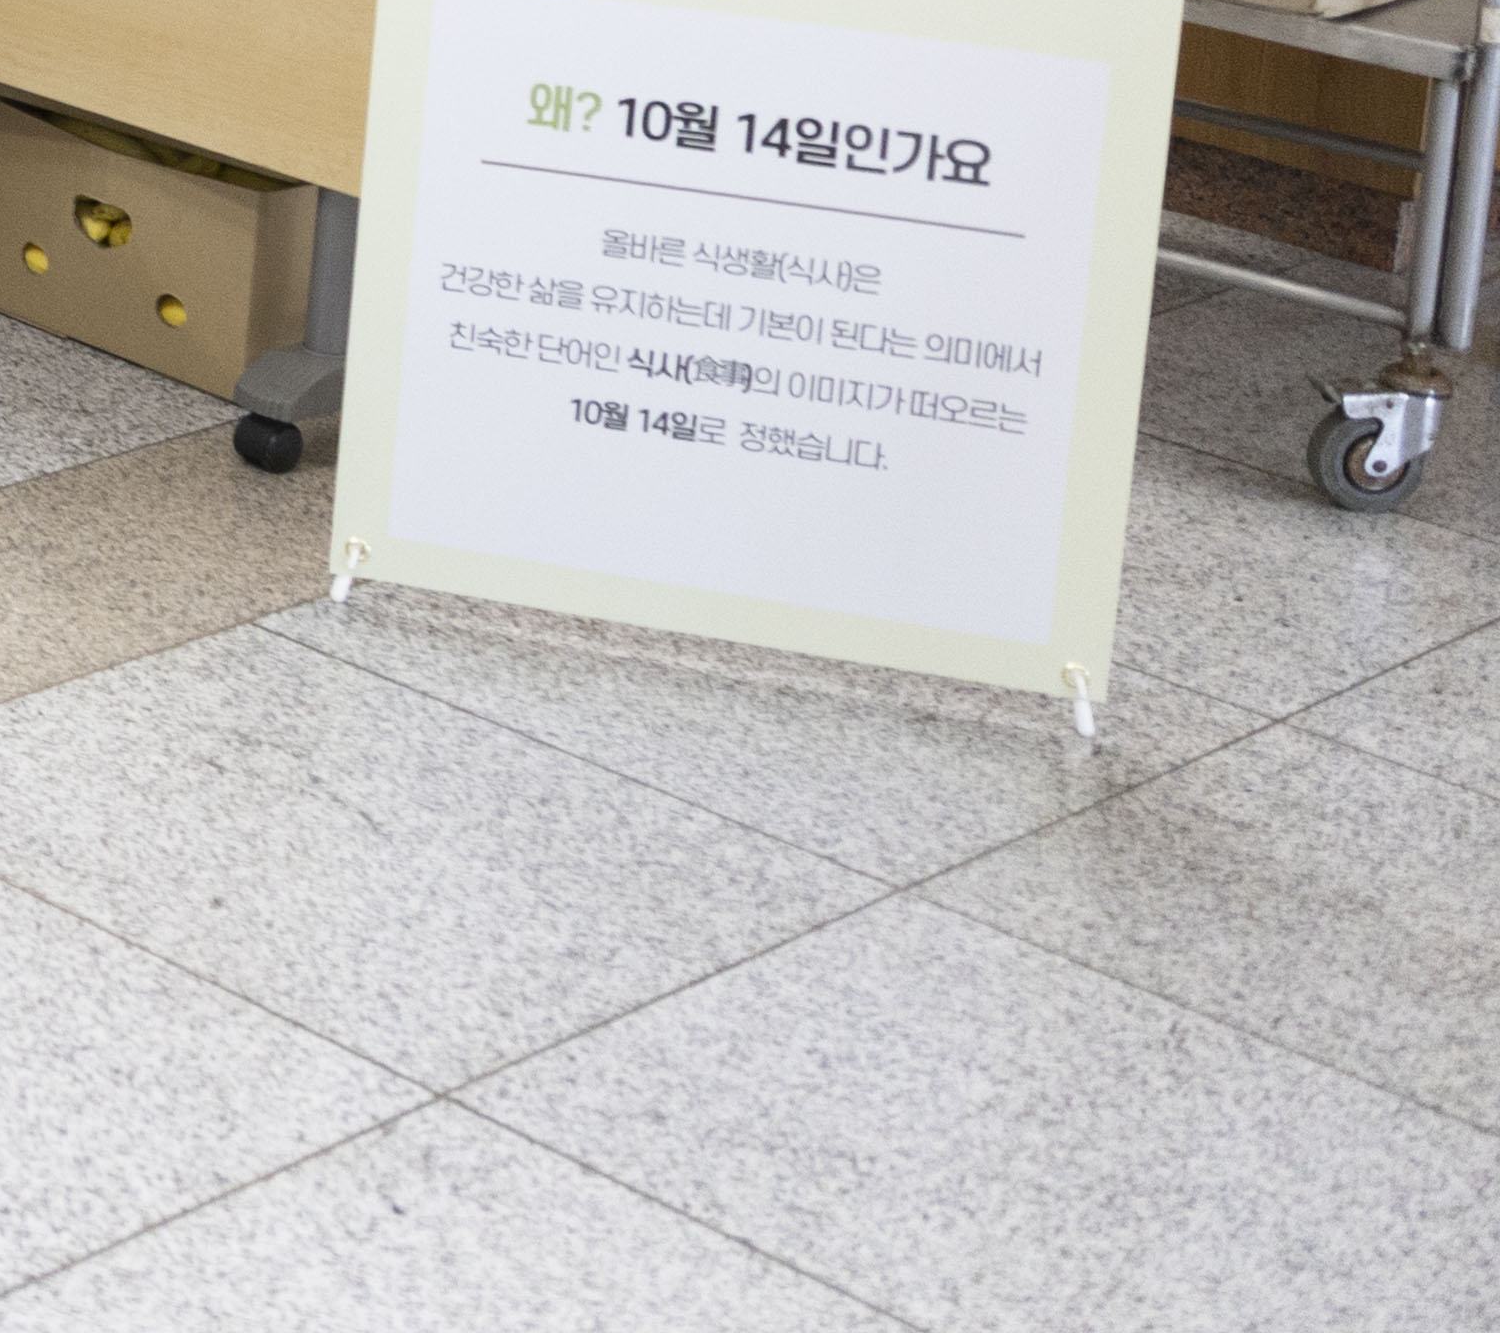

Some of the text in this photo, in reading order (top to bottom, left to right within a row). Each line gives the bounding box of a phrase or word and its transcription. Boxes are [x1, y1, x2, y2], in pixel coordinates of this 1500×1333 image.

[528, 83, 992, 187] 왜? 10월 14일인가요
[602, 229, 881, 296] 올바른 식생활(식사)은
[441, 263, 1043, 378] 건강한 삶을 유지하는데 기본이 된다는 의미에서
[450, 321, 534, 359] 친숙한
[538, 333, 620, 373] 단어인
[788, 371, 904, 415] 이미지가
[910, 389, 1028, 435] 떠오르는
[571, 399, 889, 471] 10월 14일로 정했습니다.
